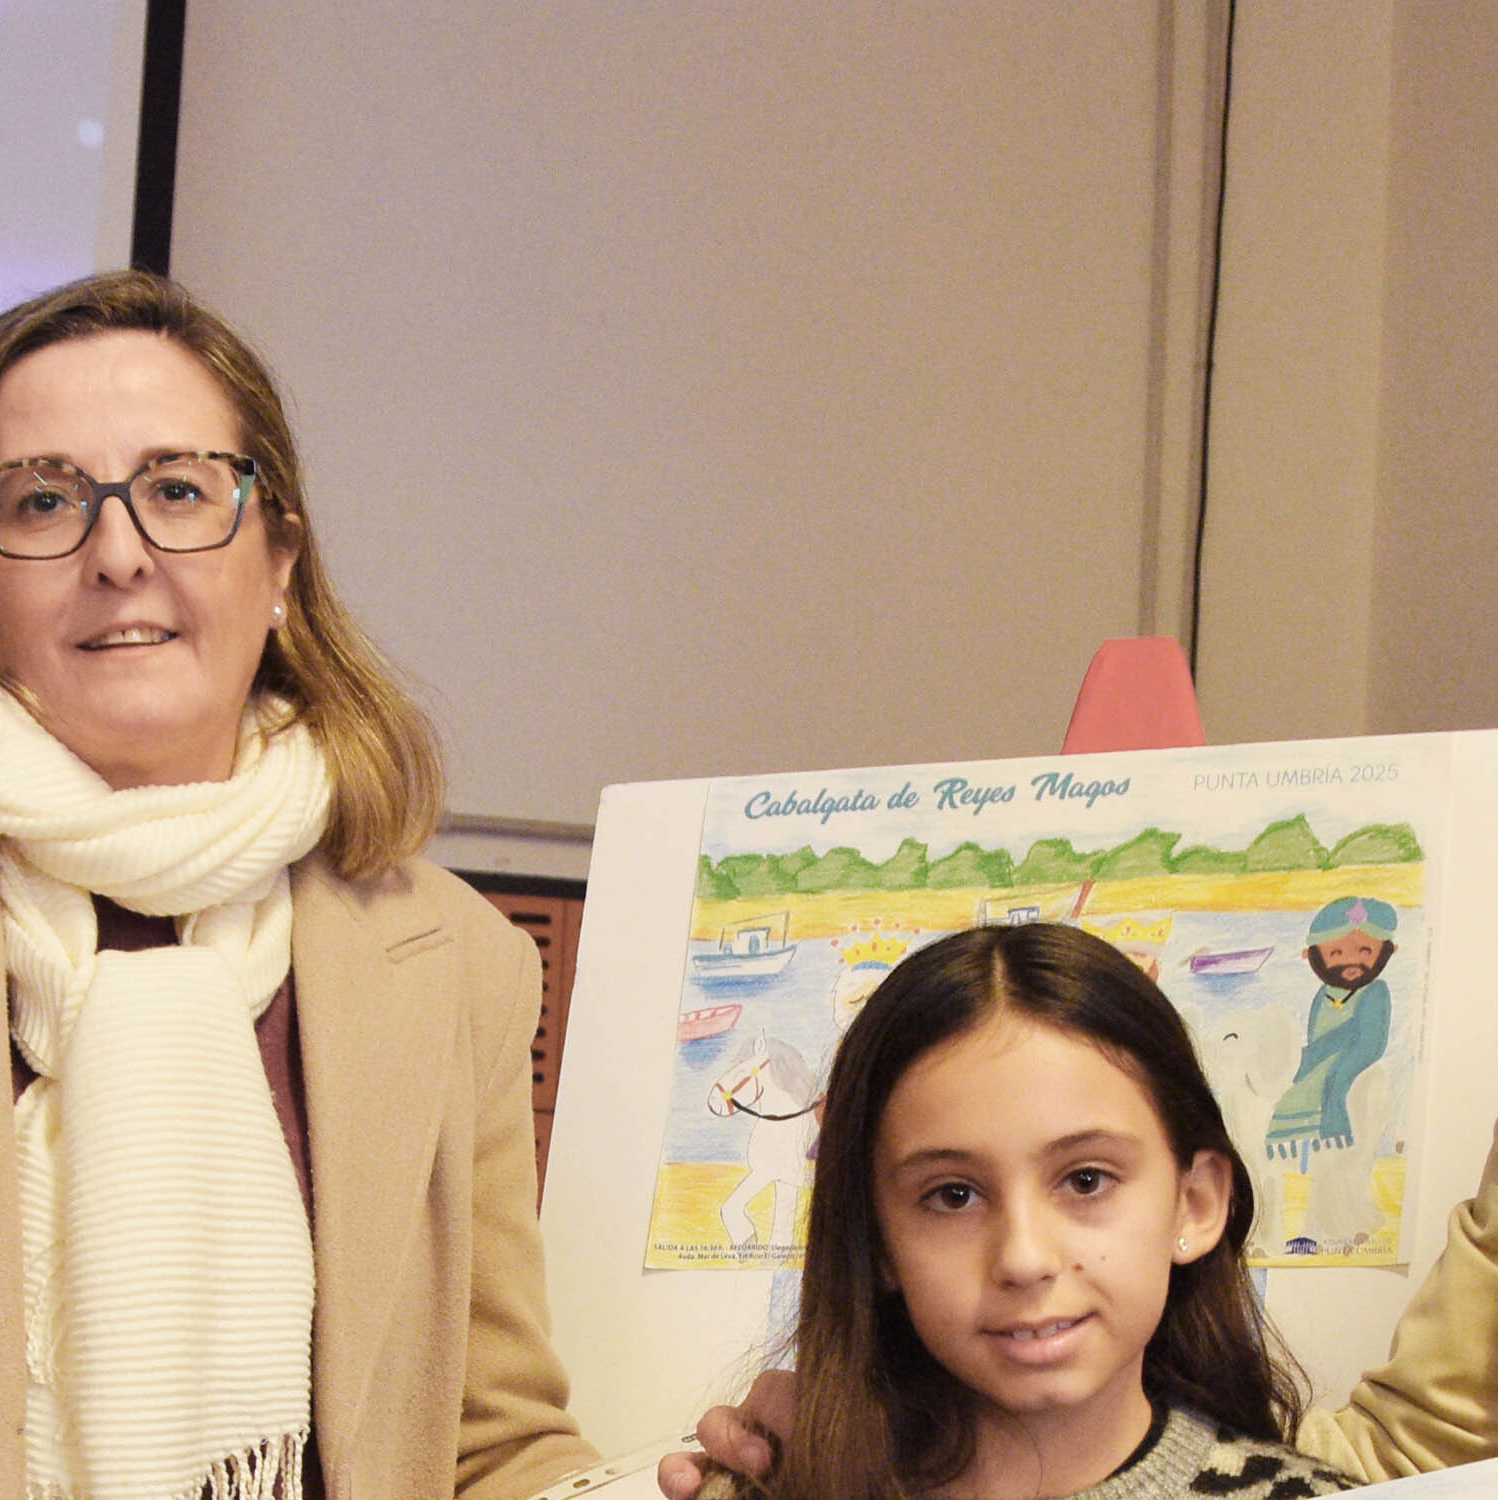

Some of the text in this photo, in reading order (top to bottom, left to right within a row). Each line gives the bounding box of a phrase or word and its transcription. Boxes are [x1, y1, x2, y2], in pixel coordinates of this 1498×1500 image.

[743, 771, 1132, 825] Cabalgata de Reyes Magos
[1192, 763, 1399, 792] PUNTA UMBRÍA 2025
